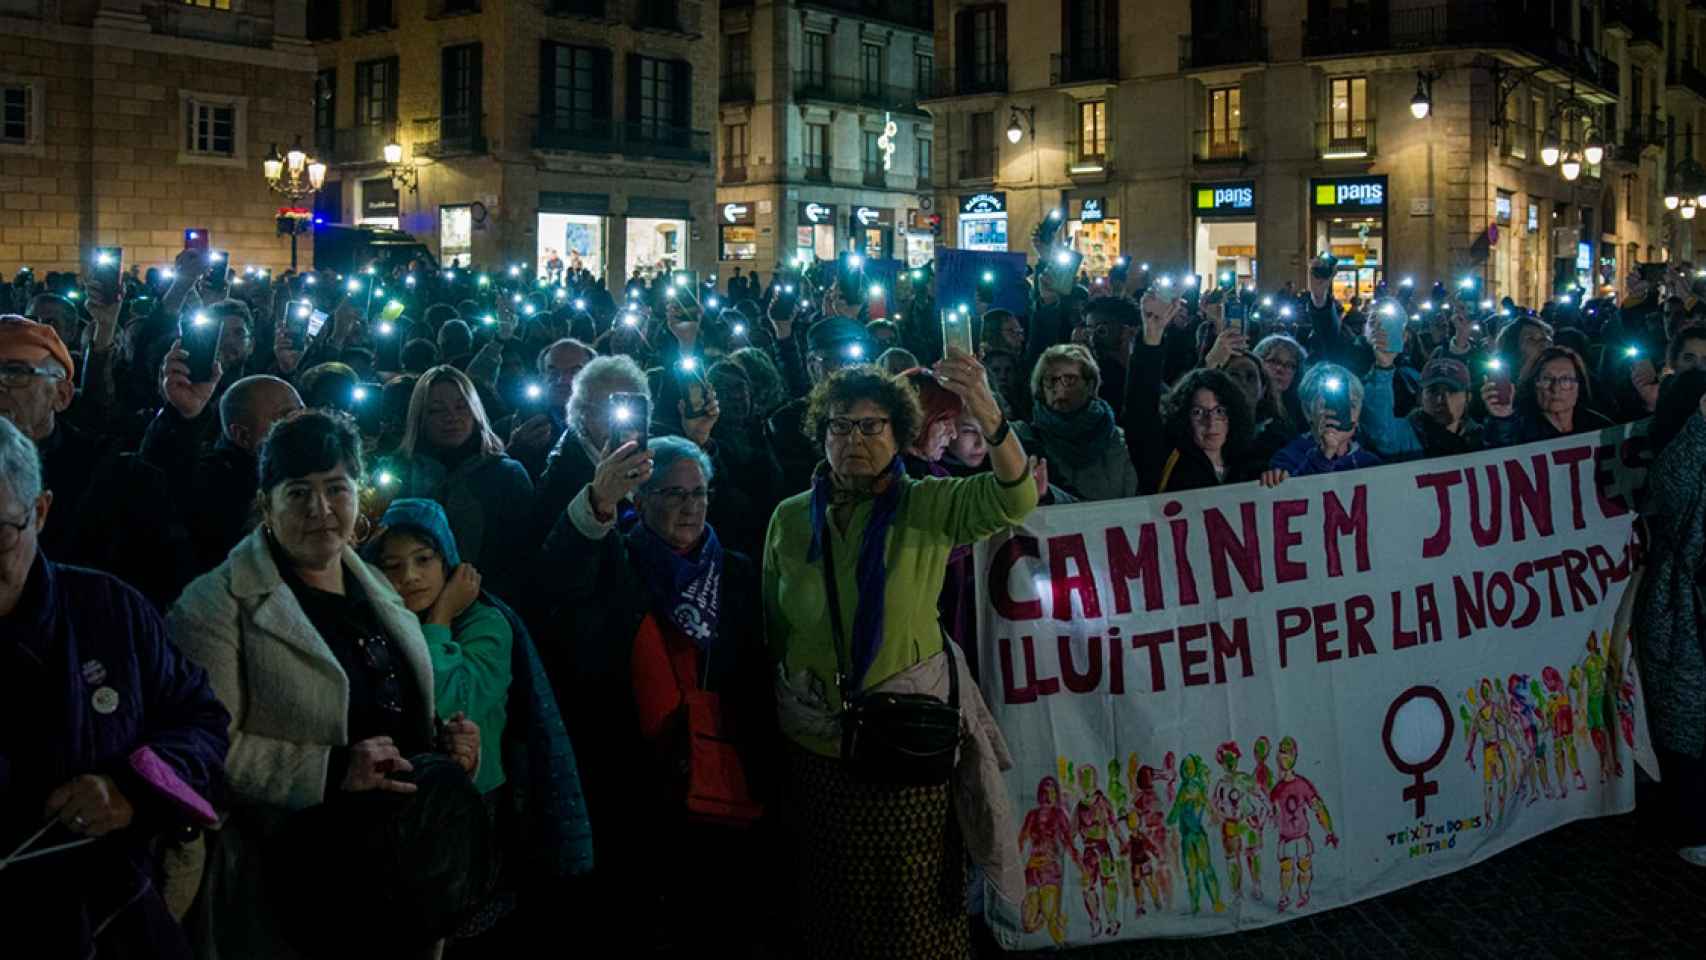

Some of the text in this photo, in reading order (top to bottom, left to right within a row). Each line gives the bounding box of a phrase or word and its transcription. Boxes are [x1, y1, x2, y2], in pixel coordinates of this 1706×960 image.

[1215, 189, 1252, 207] pans
[1338, 185, 1382, 204] pans
[1417, 442, 1650, 558] JUNTES
[1278, 594, 1376, 668] PER
[1390, 585, 1441, 650] LA
[1457, 546, 1614, 639] NOSTRA
